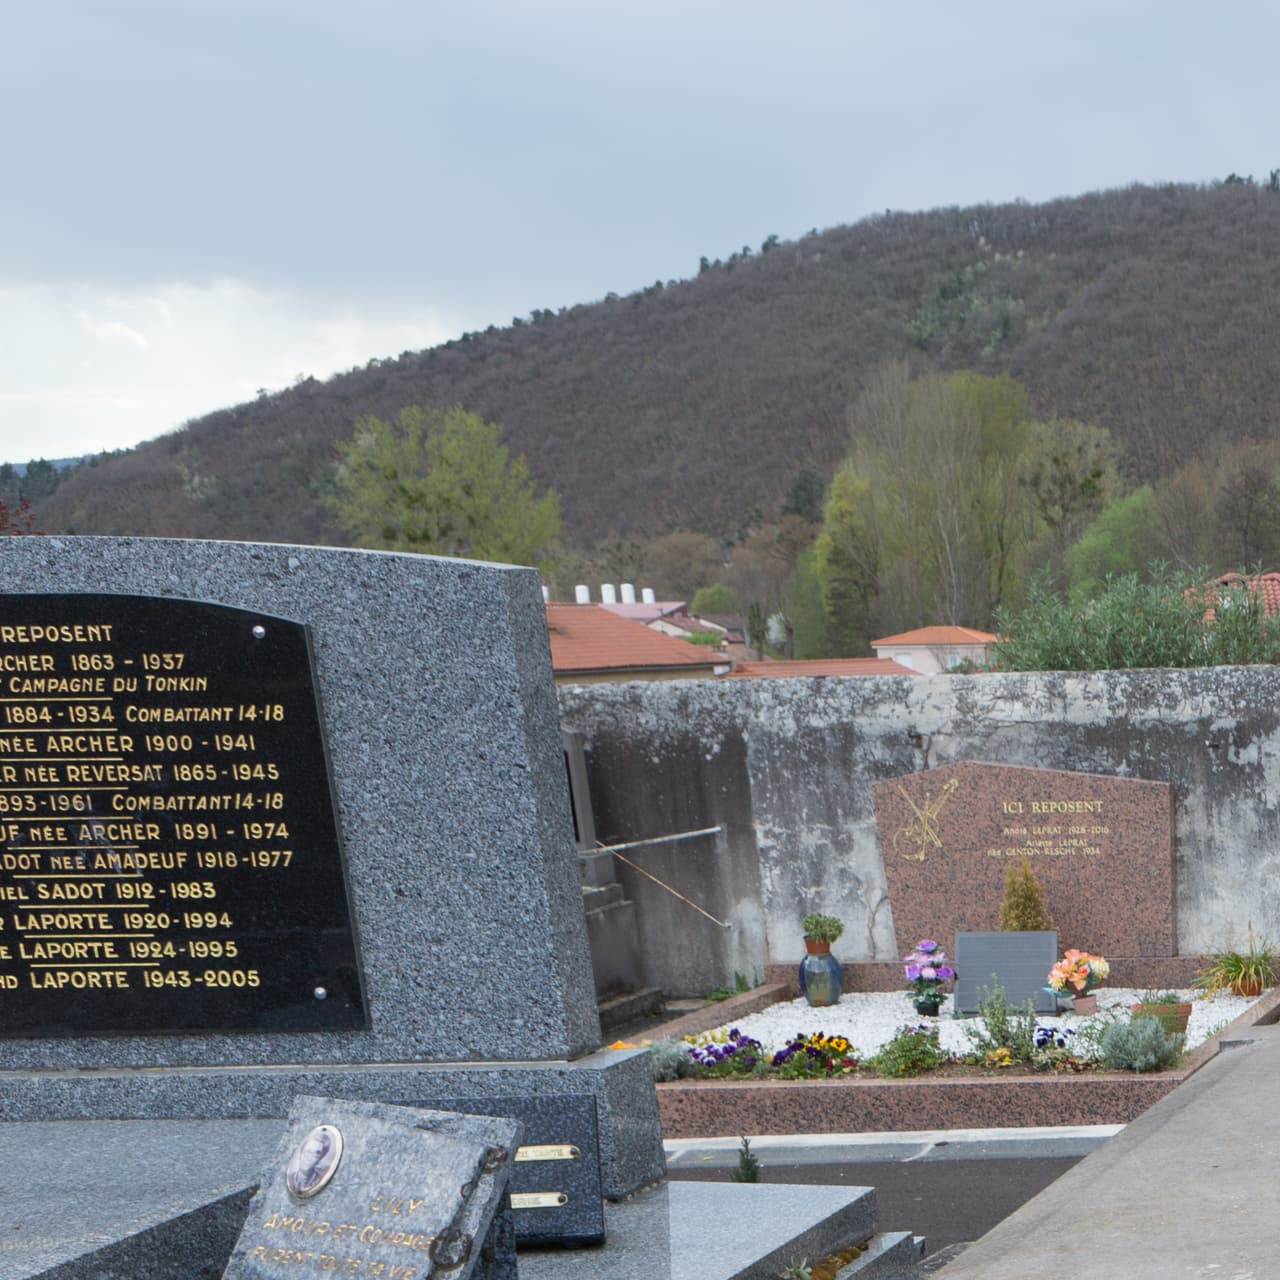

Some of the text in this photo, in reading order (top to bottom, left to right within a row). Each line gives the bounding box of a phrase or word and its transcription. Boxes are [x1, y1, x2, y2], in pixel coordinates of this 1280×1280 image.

[1, 624, 113, 643] REPOSENT
[0, 654, 55, 671] CHER
[71, 654, 115, 671] 1863
[142, 653, 185, 670] 1937
[9, 675, 208, 693] CAMPAGNE DU TONKIN
[125, 705, 234, 722] COMBATTANT
[47, 735, 134, 752] ARCHER
[145, 735, 193, 752] 1900
[214, 734, 256, 752] 1941
[66, 764, 163, 782] REVERSAT
[112, 793, 232, 811] COMBATTANT
[1002, 801, 1104, 814] ICI REPOSENT
[79, 824, 161, 841] ARCHER
[174, 823, 217, 840] 1891
[243, 823, 289, 840] 1974
[0, 853, 41, 870] DOT
[94, 852, 188, 870] AMADEUF
[37, 883, 106, 900] SADOT
[13, 913, 113, 930] LAPORTE
[19, 942, 119, 958] LAPORTE
[30, 971, 130, 989] LAPORTE
[370, 1194, 425, 1217] LILY
[331, 1224, 358, 1240] ET
